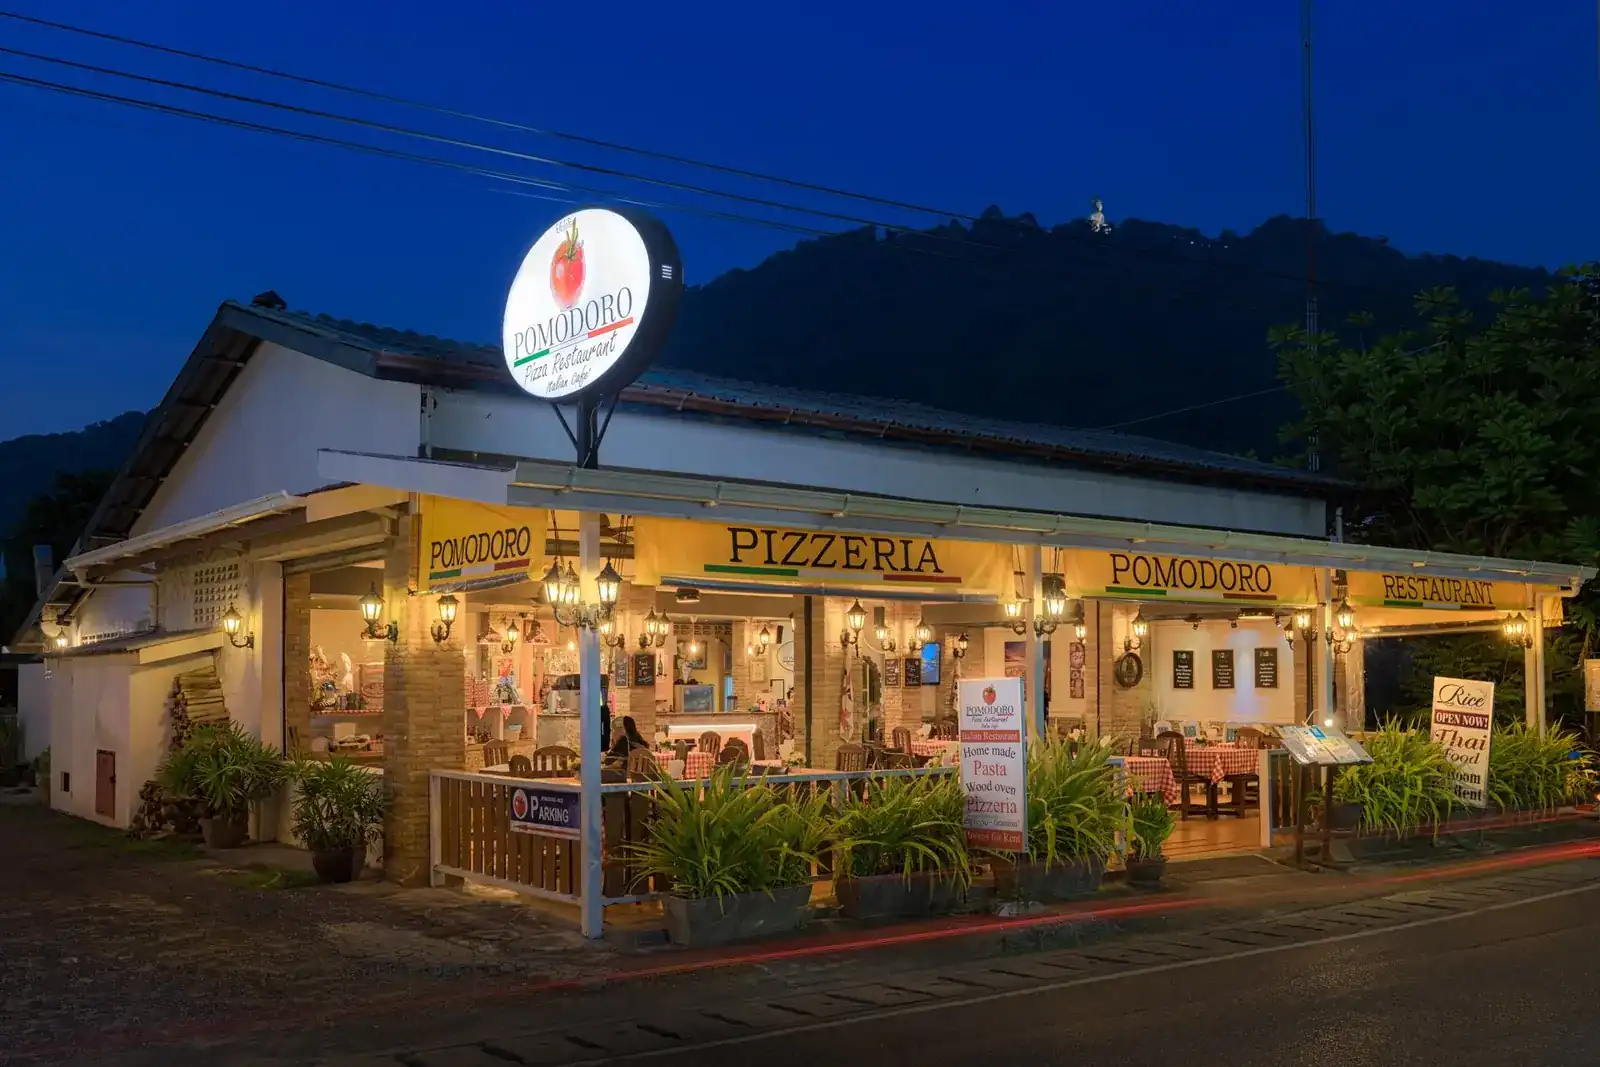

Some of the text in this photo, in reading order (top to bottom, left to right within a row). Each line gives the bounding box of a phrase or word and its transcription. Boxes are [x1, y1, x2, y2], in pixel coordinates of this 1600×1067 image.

[514, 287, 633, 360] POMODORO
[524, 331, 618, 386] Pizza Restaurant
[546, 374, 568, 394] Italian
[430, 526, 531, 569] POMODORO
[727, 527, 945, 573] PIZZERIA
[1110, 553, 1272, 593] POMODORO
[1382, 574, 1494, 604] RESTAURANT
[1436, 683, 1485, 707] Rice
[966, 705, 1014, 715] POMODORO
[1436, 711, 1488, 728] OPEN NOW!
[983, 731, 1018, 741] Restaurant
[1435, 728, 1488, 751] Thai
[963, 747, 1016, 759] Home made
[973, 760, 1007, 776] Pasta
[966, 780, 1016, 795] Wood oven
[530, 795, 569, 823] PARKING
[967, 796, 1018, 814] Pizzeria
[1003, 833, 1021, 844] Rent
